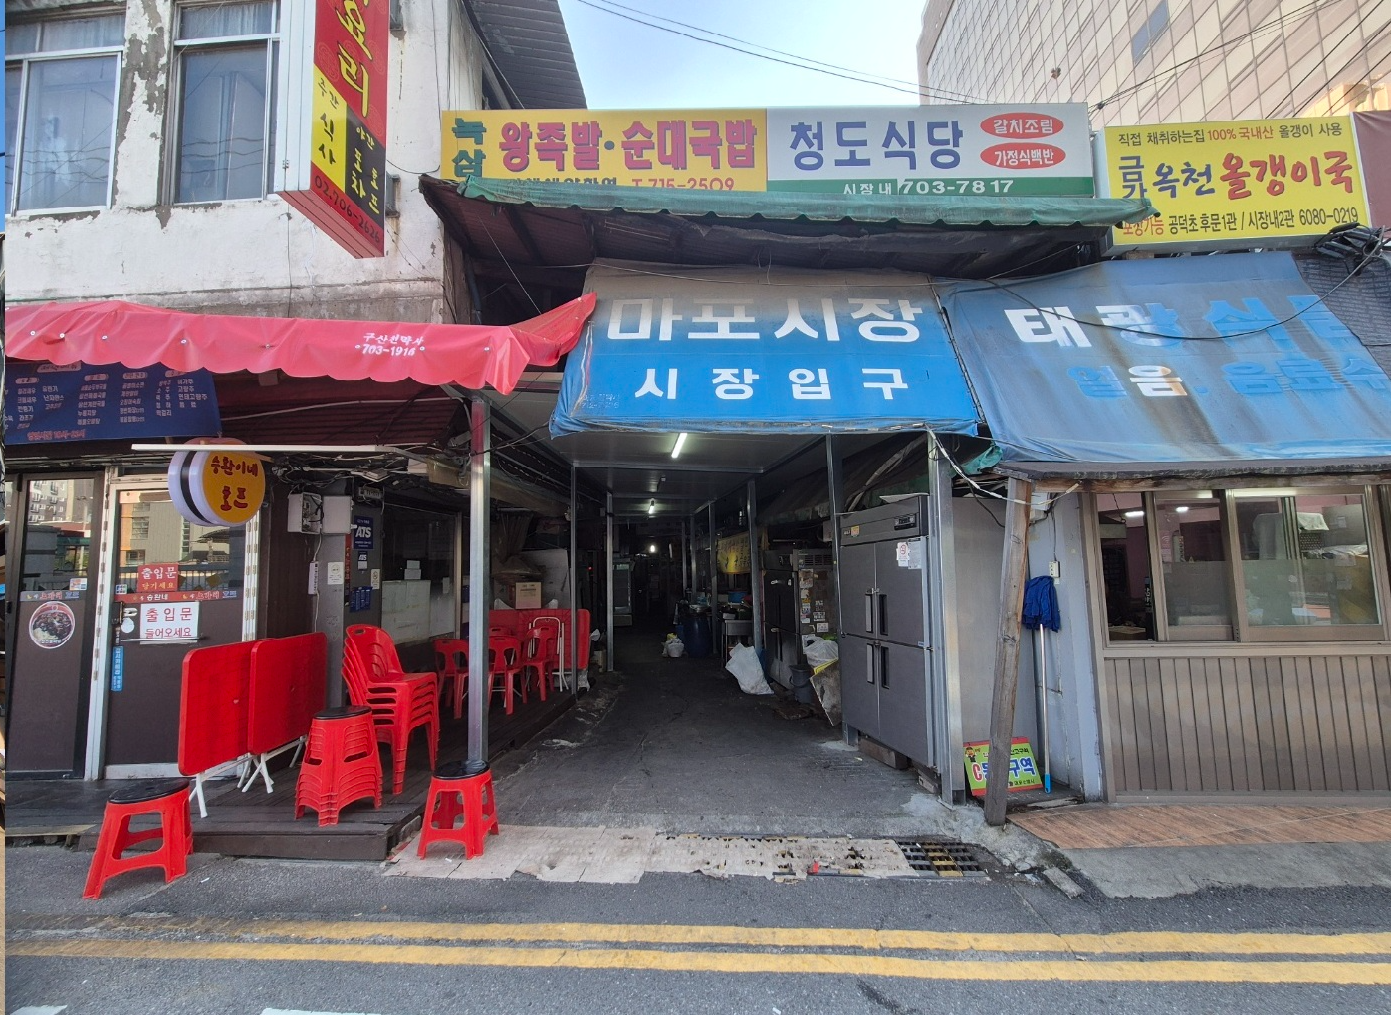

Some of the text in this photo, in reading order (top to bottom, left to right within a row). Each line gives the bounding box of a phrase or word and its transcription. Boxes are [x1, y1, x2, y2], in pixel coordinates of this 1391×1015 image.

[318, 77, 340, 109] 주간
[320, 112, 336, 165] 식사
[356, 126, 375, 151] 야간
[499, 119, 758, 172] 왕족발·순대국밥
[790, 118, 1054, 171] 청도식당 갈치조림
[1118, 121, 1343, 147] 직접 채취하는집 100% 국내산 올갱이 사용
[995, 148, 1055, 168] 가정식백반
[351, 148, 366, 198] 포차
[1152, 162, 1216, 199] 옥천
[1220, 150, 1354, 201] 올갱이국
[899, 179, 1015, 195] 703-7817
[1168, 212, 1198, 235] 공덕초
[1200, 211, 1238, 232] 후문1관
[1248, 207, 1295, 230] 시장내2관
[1298, 206, 1359, 226] 6080-0219
[607, 297, 924, 343] 마포시장
[634, 367, 910, 400] 시장입구
[210, 456, 259, 477] 승환이네
[355, 526, 372, 539] ATS
[142, 567, 177, 580] 출입문
[142, 582, 175, 590] 당기세요
[146, 608, 192, 622] 출입문
[145, 627, 192, 639] 들어오세요
